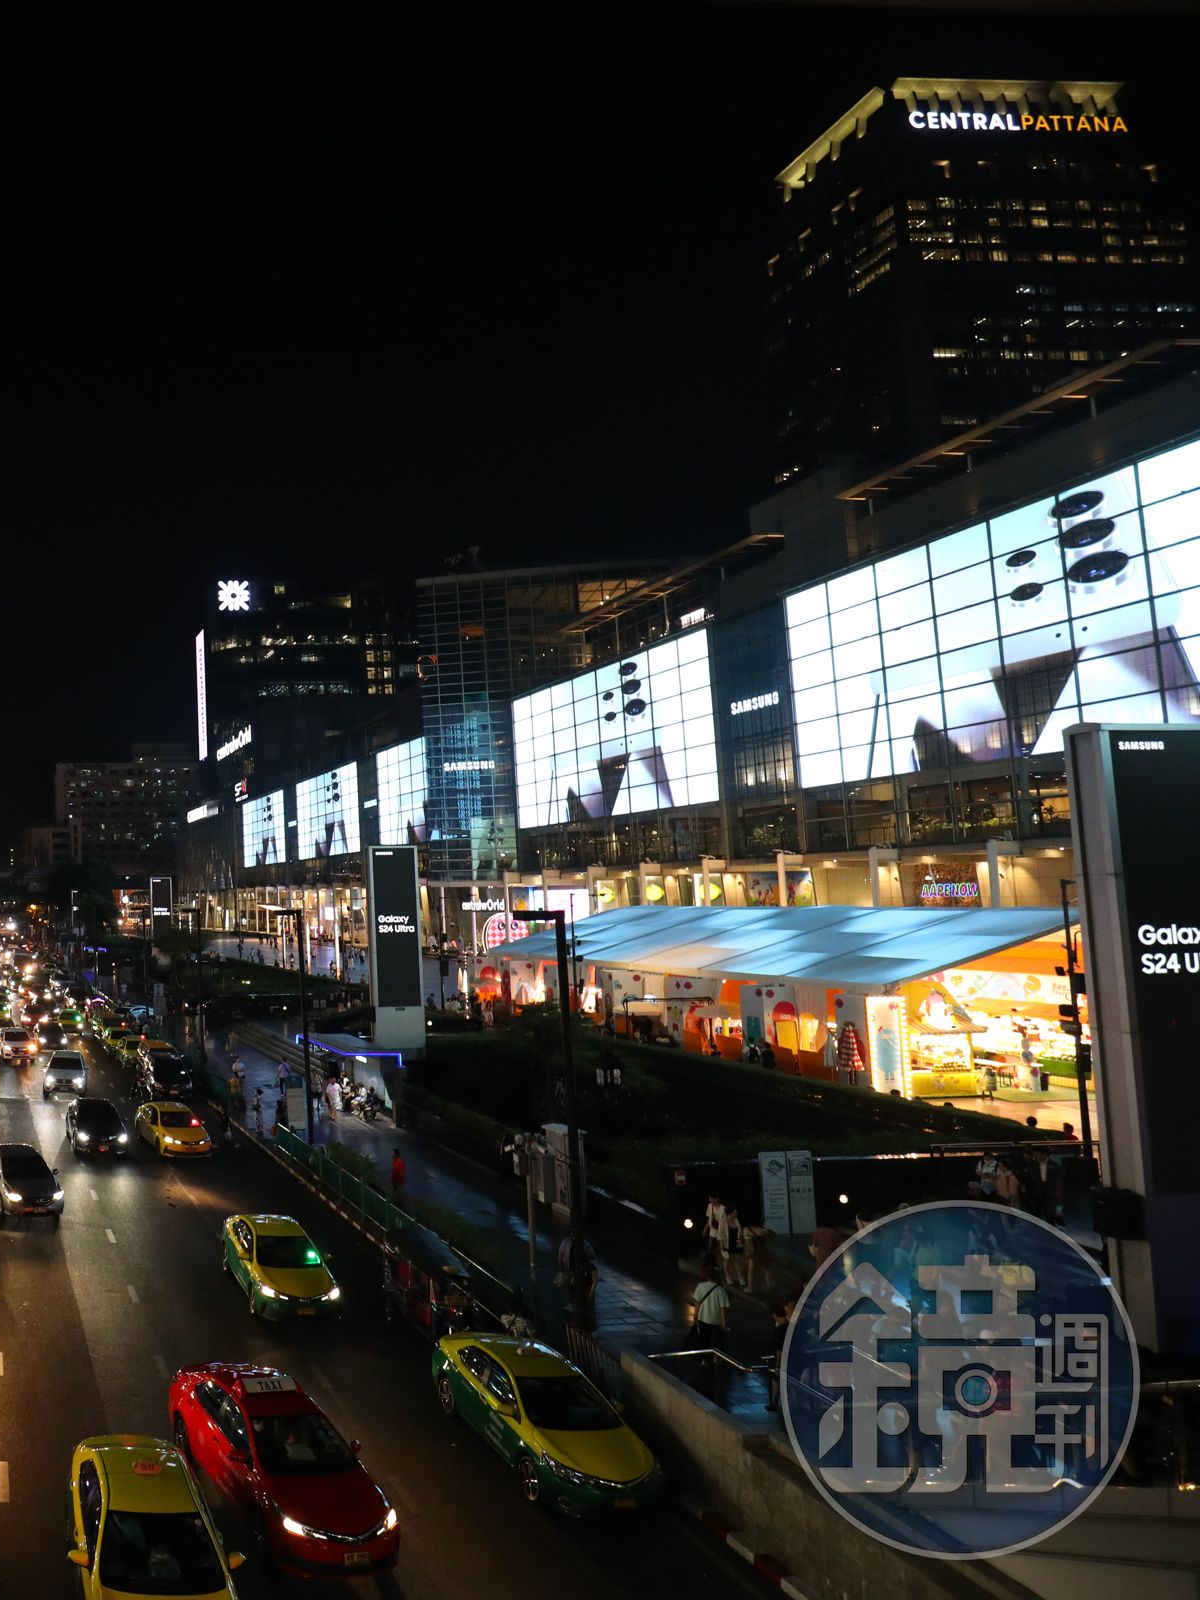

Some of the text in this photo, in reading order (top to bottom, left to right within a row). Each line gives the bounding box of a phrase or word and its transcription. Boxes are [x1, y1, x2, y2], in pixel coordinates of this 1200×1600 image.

[730, 691, 780, 715] SAMSUNG
[1118, 741, 1165, 750] SAMSUNG
[443, 760, 496, 771] SAMSUNG
[377, 914, 409, 925] Galaxy
[378, 924, 415, 933] S24 Ultra
[1138, 924, 1200, 945] Galax
[1141, 953, 1181, 974] S24
[257, 1380, 283, 1391] TAXI
